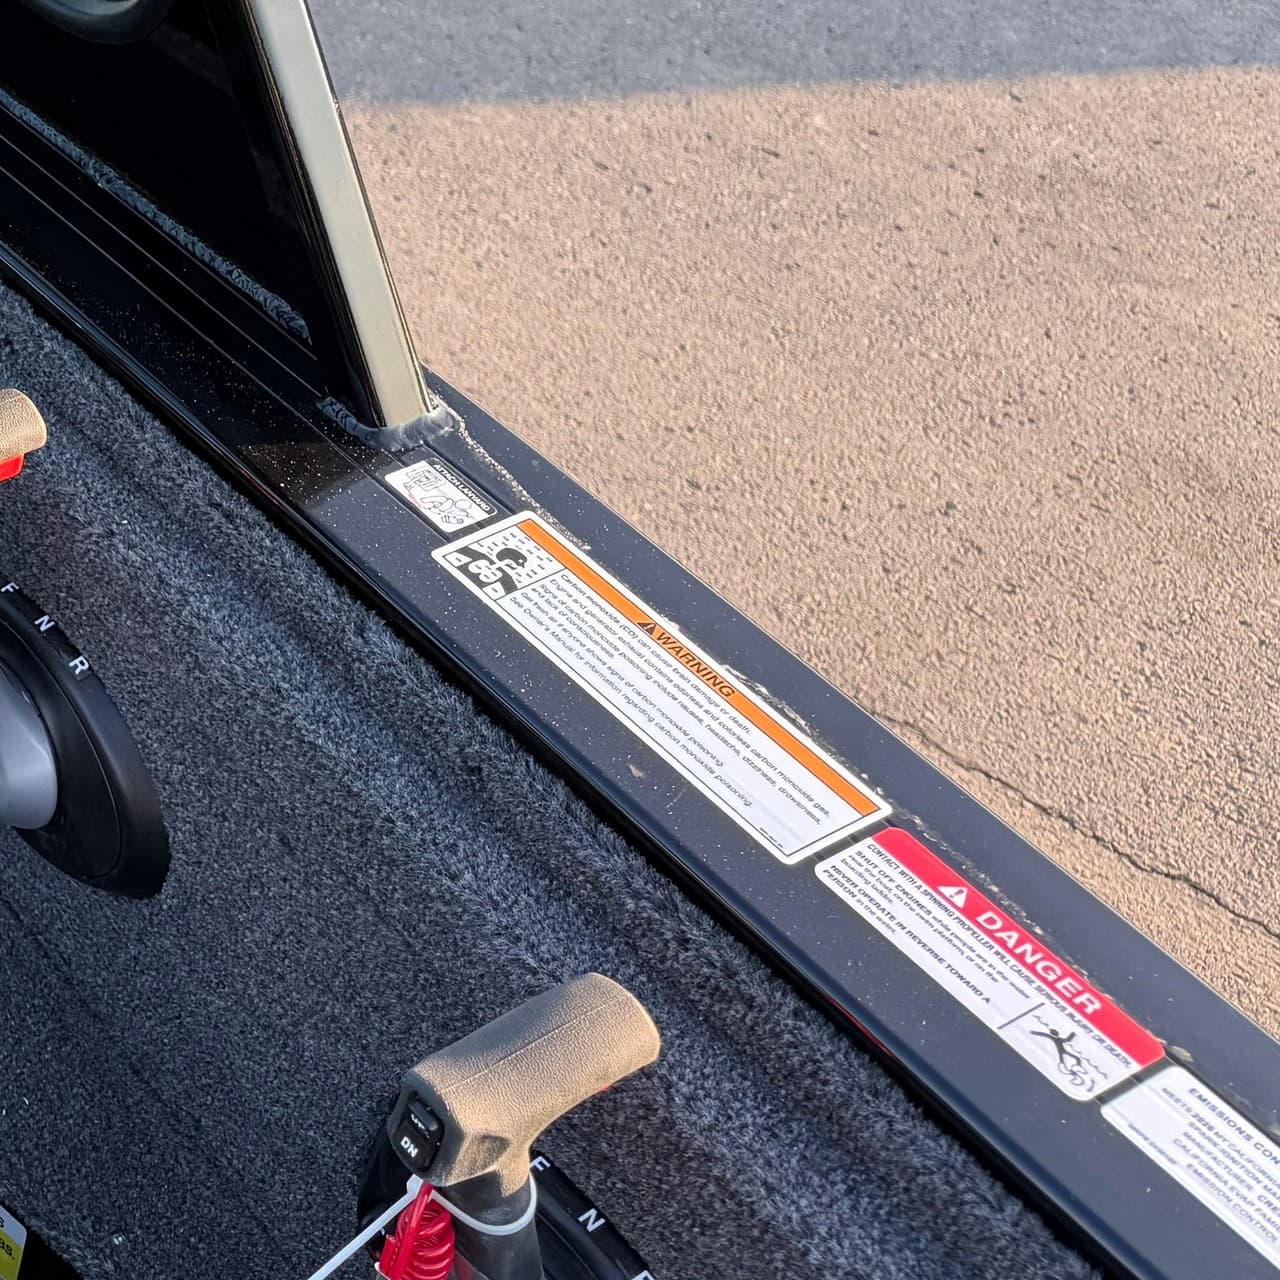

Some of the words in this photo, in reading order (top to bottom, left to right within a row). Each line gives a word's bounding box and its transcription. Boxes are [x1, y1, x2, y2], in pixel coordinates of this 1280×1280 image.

[433, 463, 460, 485] ATTACH
[456, 484, 493, 512] LANYARD
[0, 582, 20, 594] F
[529, 586, 546, 599] and
[543, 598, 560, 611] lack
[556, 609, 567, 617] of
[34, 615, 57, 633] N
[536, 582, 560, 600] Signs
[556, 598, 567, 606] of
[563, 604, 590, 625] carbon
[585, 623, 621, 652] monoxide
[616, 651, 654, 681] poisoning
[650, 679, 679, 701] include
[558, 573, 588, 596] Carbon
[584, 594, 621, 624] monoxide
[617, 623, 639, 639] (CO)
[636, 638, 652, 650] can
[649, 649, 673, 668] cause
[670, 667, 693, 684] brain
[687, 682, 721, 708] damage
[718, 707, 730, 716] or
[68, 656, 91, 676] R
[508, 595, 525, 609] See
[548, 630, 576, 652] Manual
[572, 651, 587, 661] for
[582, 660, 624, 693] information
[619, 692, 657, 723] regarding
[653, 721, 682, 744] carbon
[678, 743, 717, 775] monoxide
[531, 601, 552, 617] fresh
[558, 625, 588, 648] anyone
[584, 646, 608, 665] shows
[604, 665, 626, 682] signs
[623, 680, 635, 689] of
[630, 686, 658, 708] carbon
[654, 707, 691, 737] monoxide
[547, 578, 574, 598] Engine
[571, 597, 587, 610] and
[583, 608, 620, 637] generator
[615, 635, 646, 658] exhaust
[642, 657, 675, 683] contains
[702, 707, 720, 721] and
[748, 747, 779, 771] carbon
[774, 770, 816, 803] monoxide
[653, 632, 738, 698] WARNING
[828, 864, 859, 889] NEVER
[855, 887, 897, 922] OPERATE
[894, 920, 907, 930] IN
[904, 929, 947, 964] REVERSE
[943, 963, 985, 997] TOWARD
[981, 995, 993, 1003] A
[865, 842, 900, 870] CONTACT
[896, 869, 918, 885] WITH
[912, 882, 924, 891] A
[918, 887, 956, 918] SPINNING
[951, 915, 996, 951] PROPELLER
[991, 949, 1014, 966] WILL
[1007, 963, 1036, 985] CAUSE
[973, 909, 1106, 1015] DANGER
[1186, 1086, 1255, 1142] EMISSIONS
[400, 1136, 419, 1159] DN
[529, 1155, 552, 1172] F
[1170, 1137, 1231, 1187] CALIFORNIA
[1184, 1162, 1234, 1203] EMISSION
[578, 1208, 606, 1233] N
